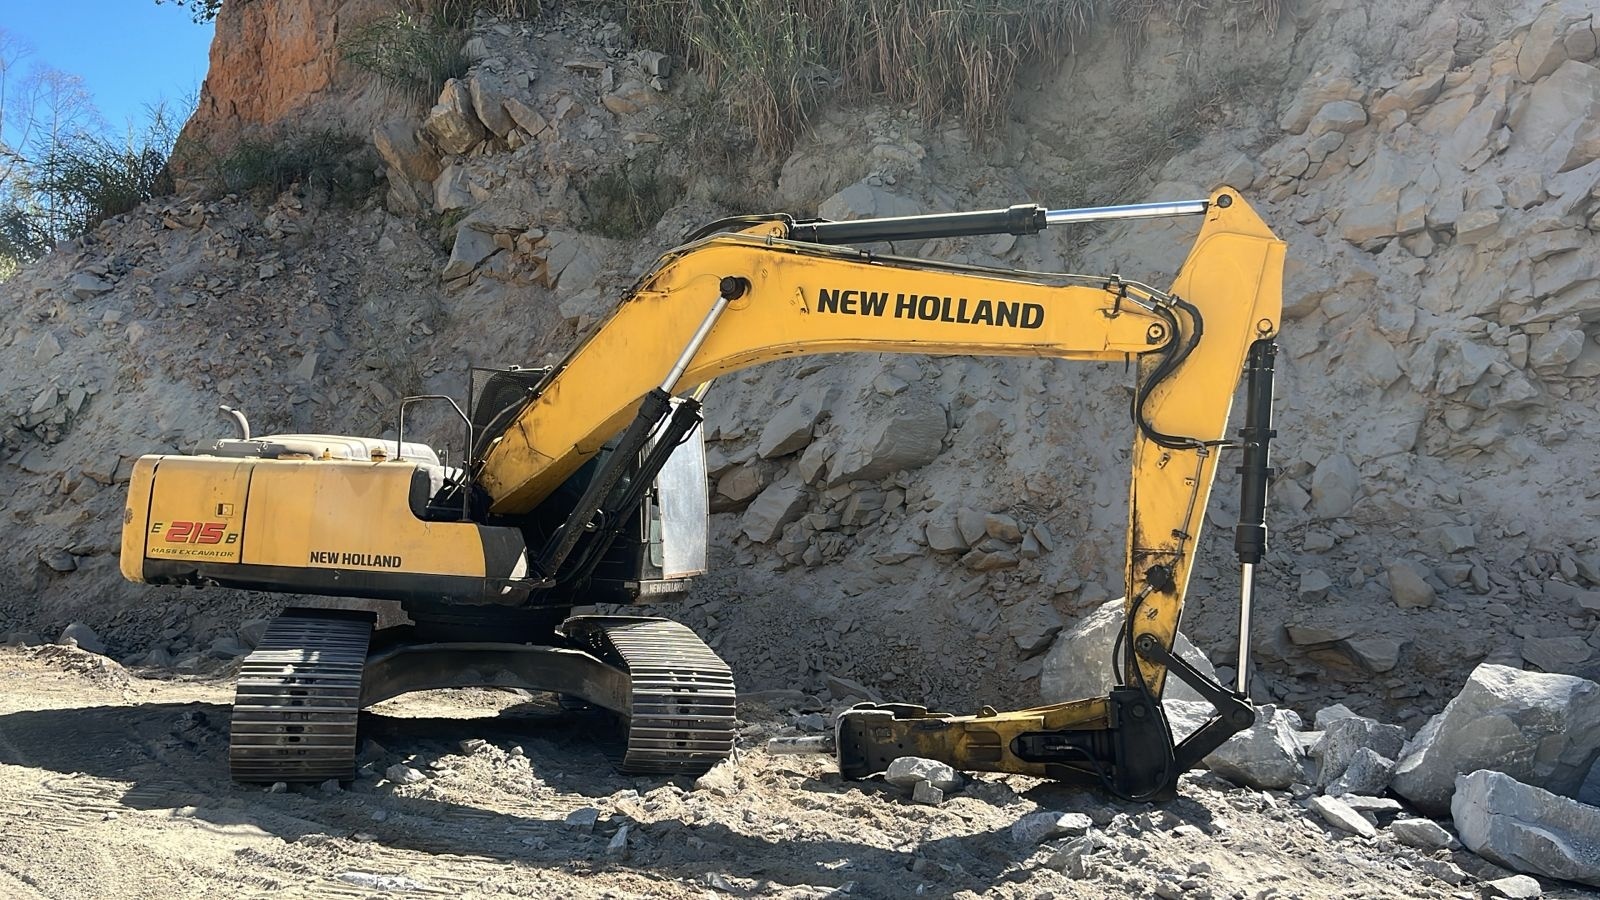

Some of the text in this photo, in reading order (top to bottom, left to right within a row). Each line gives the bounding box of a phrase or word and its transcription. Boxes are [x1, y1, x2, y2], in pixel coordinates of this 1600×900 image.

[817, 288, 1045, 329] NEW HOLLAND
[151, 522, 239, 544] E 215 B
[151, 547, 234, 557] MASS EXCAVATOR
[310, 551, 402, 568] NEW HOLLAND
[649, 583, 662, 593] NEW
